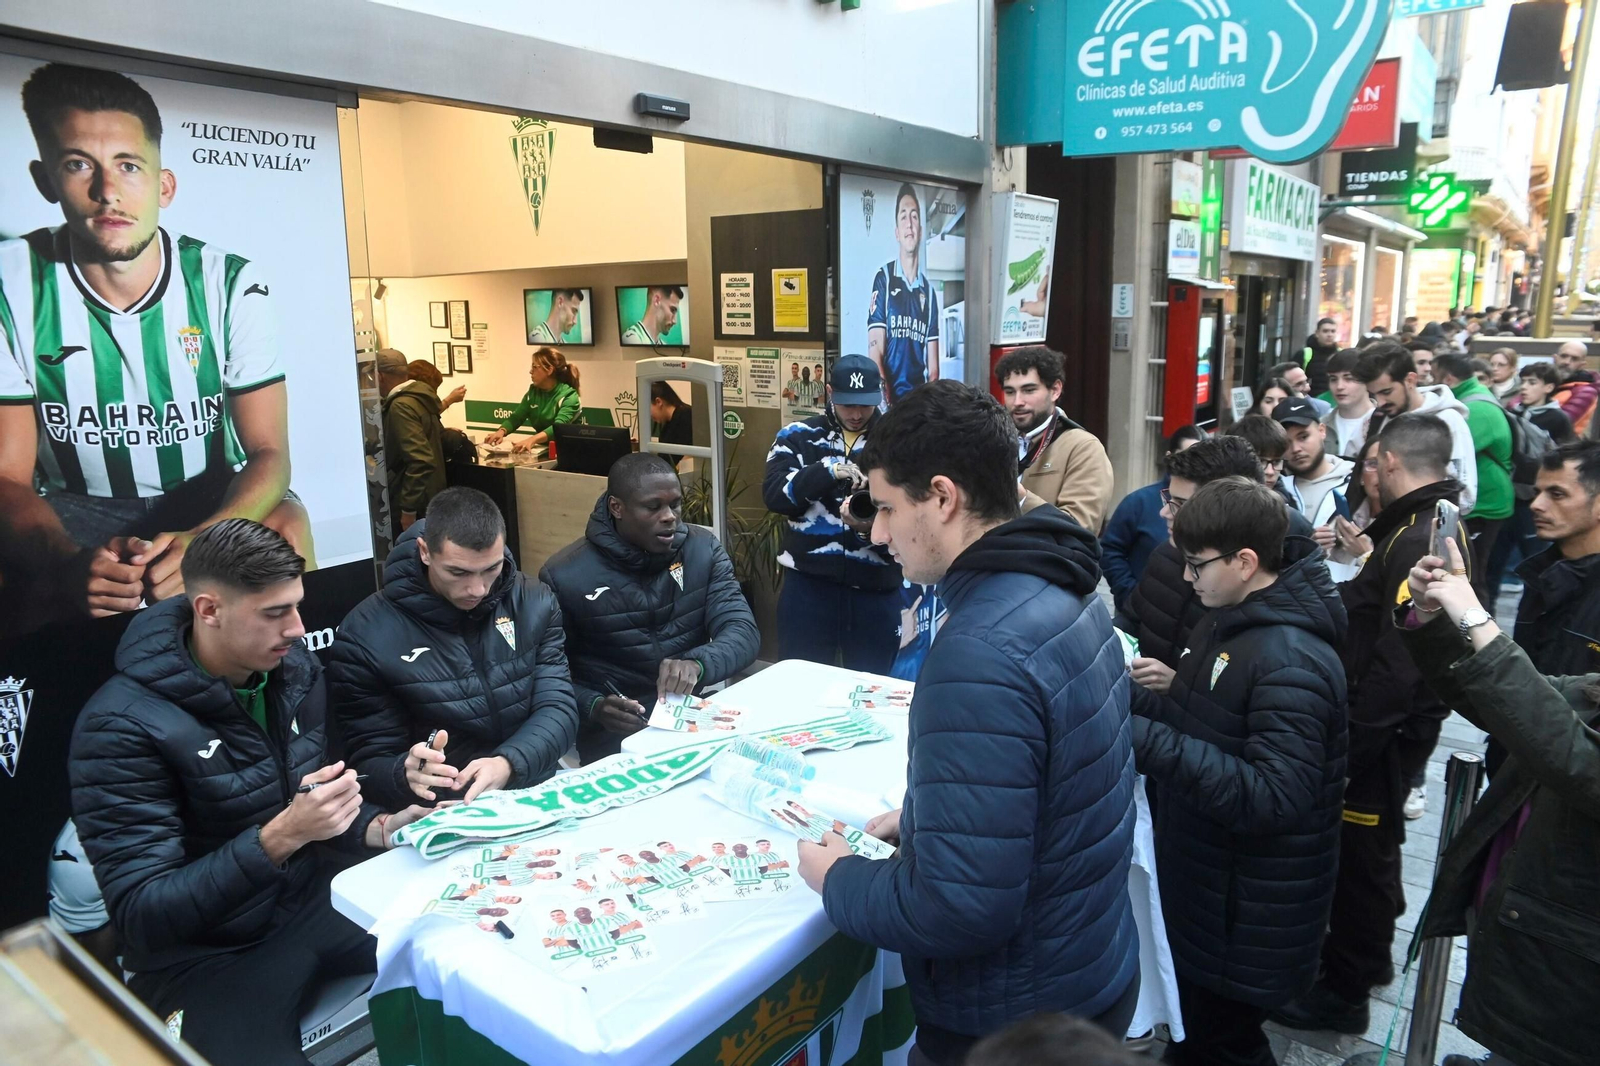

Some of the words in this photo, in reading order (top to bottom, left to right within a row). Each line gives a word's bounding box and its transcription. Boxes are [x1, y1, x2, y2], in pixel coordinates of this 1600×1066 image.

[1077, 21, 1248, 78] EFETA
[1076, 83, 1126, 101] Clínicas
[1129, 79, 1146, 97] de
[1148, 74, 1186, 95] Salud
[1189, 71, 1246, 92] Auditiva
[1113, 100, 1204, 118] www.efeta.es
[181, 121, 289, 147] “LUCIENDO
[291, 134, 316, 150] TU
[1121, 125, 1143, 137] 957
[1145, 123, 1168, 135] 473
[1170, 121, 1193, 133] 564
[192, 148, 249, 167] GRAN
[251, 152, 311, 172] VALÍA”
[1345, 169, 1408, 183] TIENDAS
[1246, 164, 1316, 232] FARMACIA
[890, 315, 926, 334] BAHRAIN
[850, 372, 864, 388] NY
[42, 394, 224, 429] BAHRAIN
[47, 415, 225, 448] VICTORIOUS
